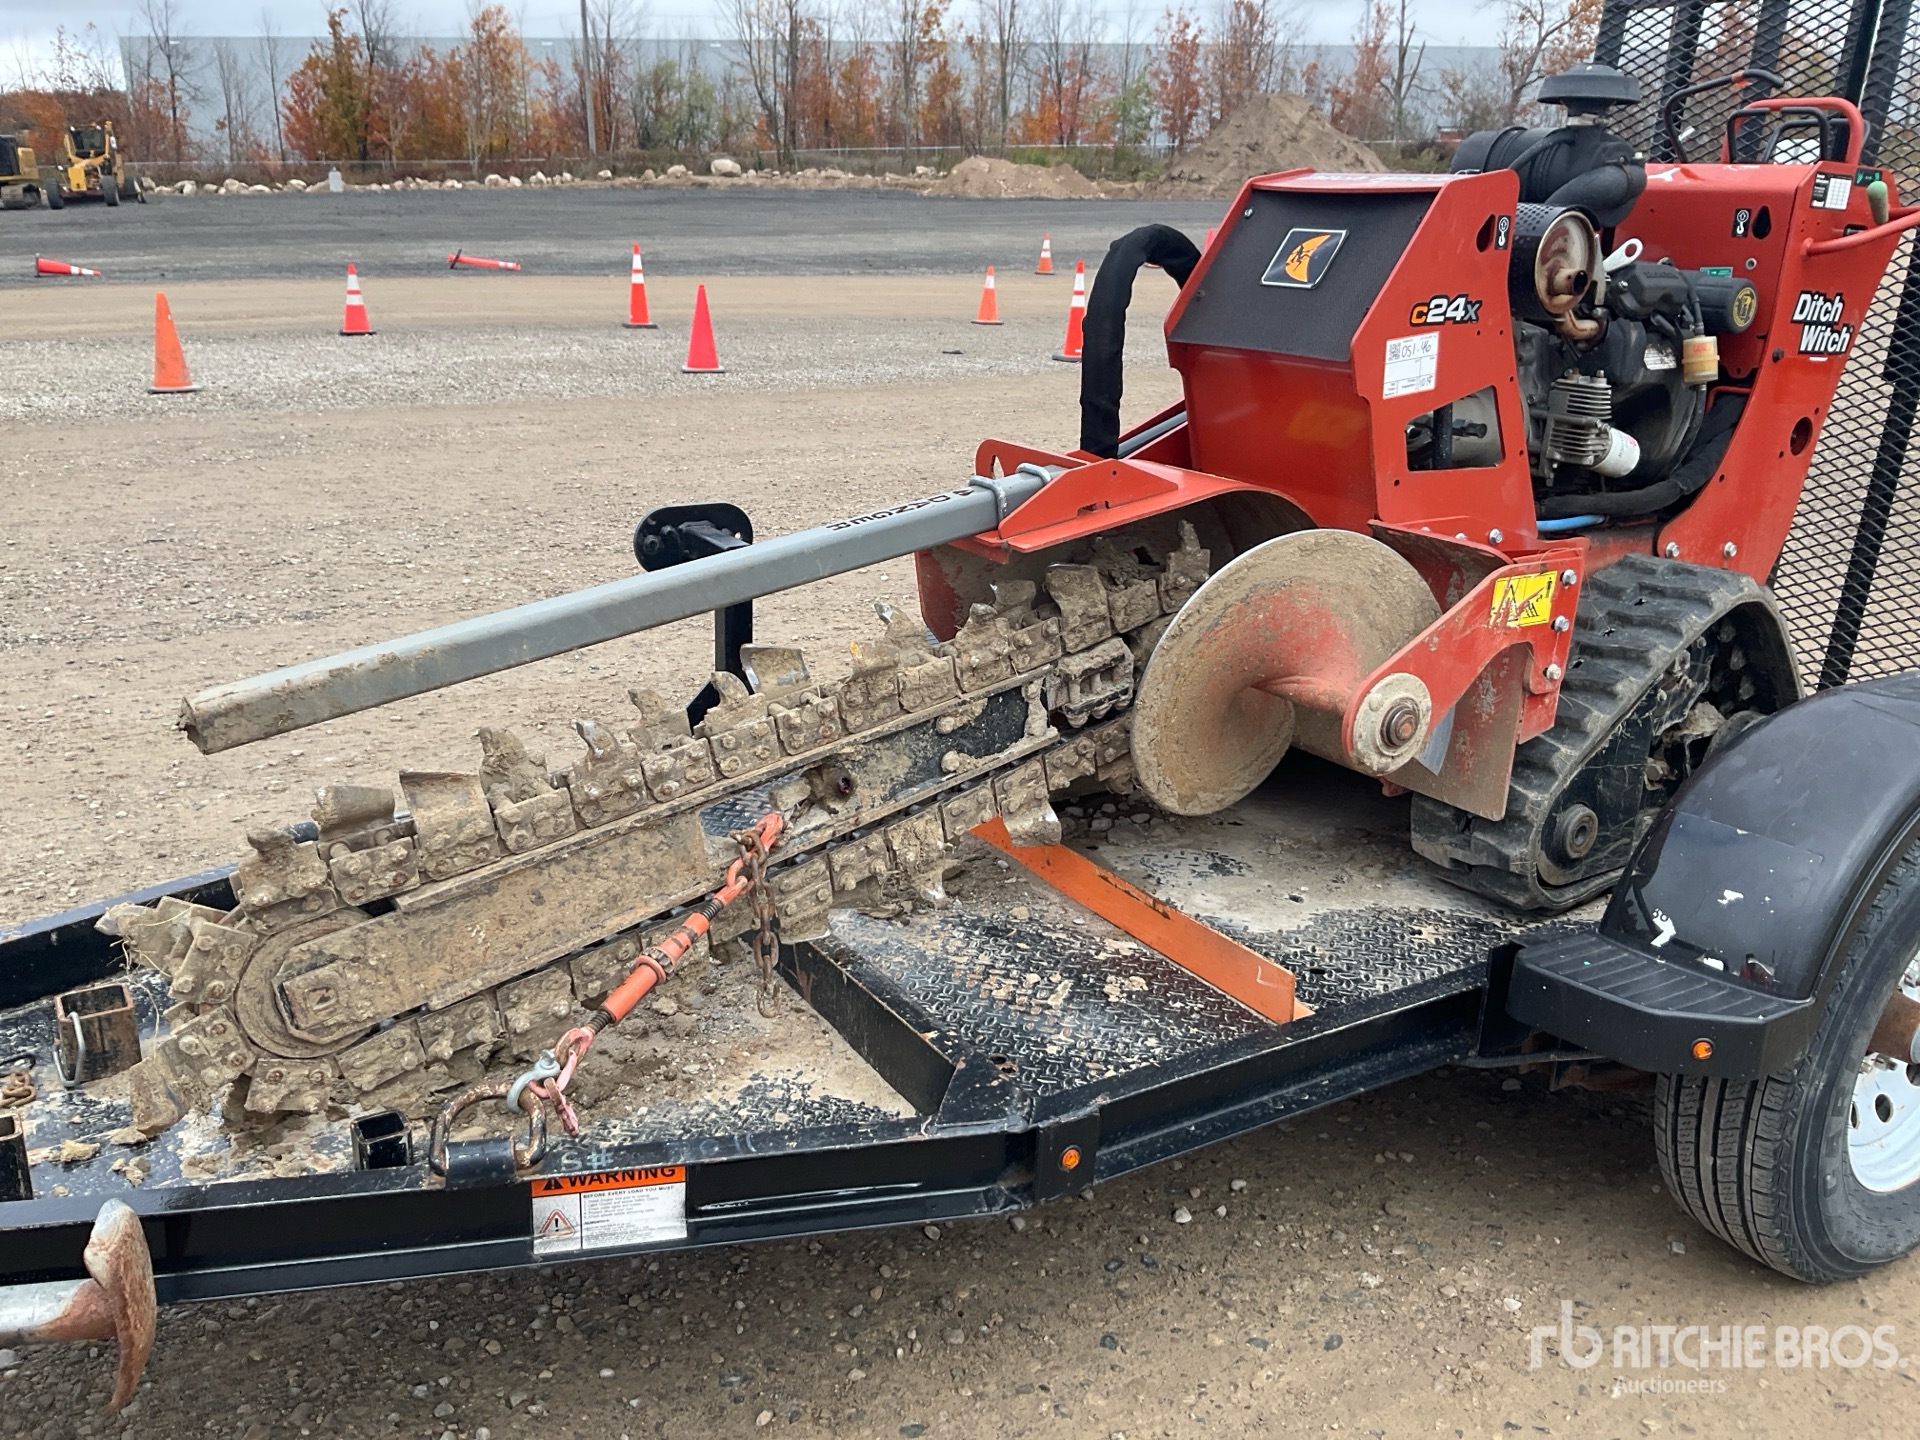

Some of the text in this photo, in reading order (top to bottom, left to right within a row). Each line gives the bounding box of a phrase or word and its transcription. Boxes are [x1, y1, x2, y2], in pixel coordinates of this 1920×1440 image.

[1792, 293, 1844, 322] Ditch
[1799, 325, 1851, 353] Witch
[826, 494, 951, 531] DANGER
[568, 1167, 677, 1188] WARNING
